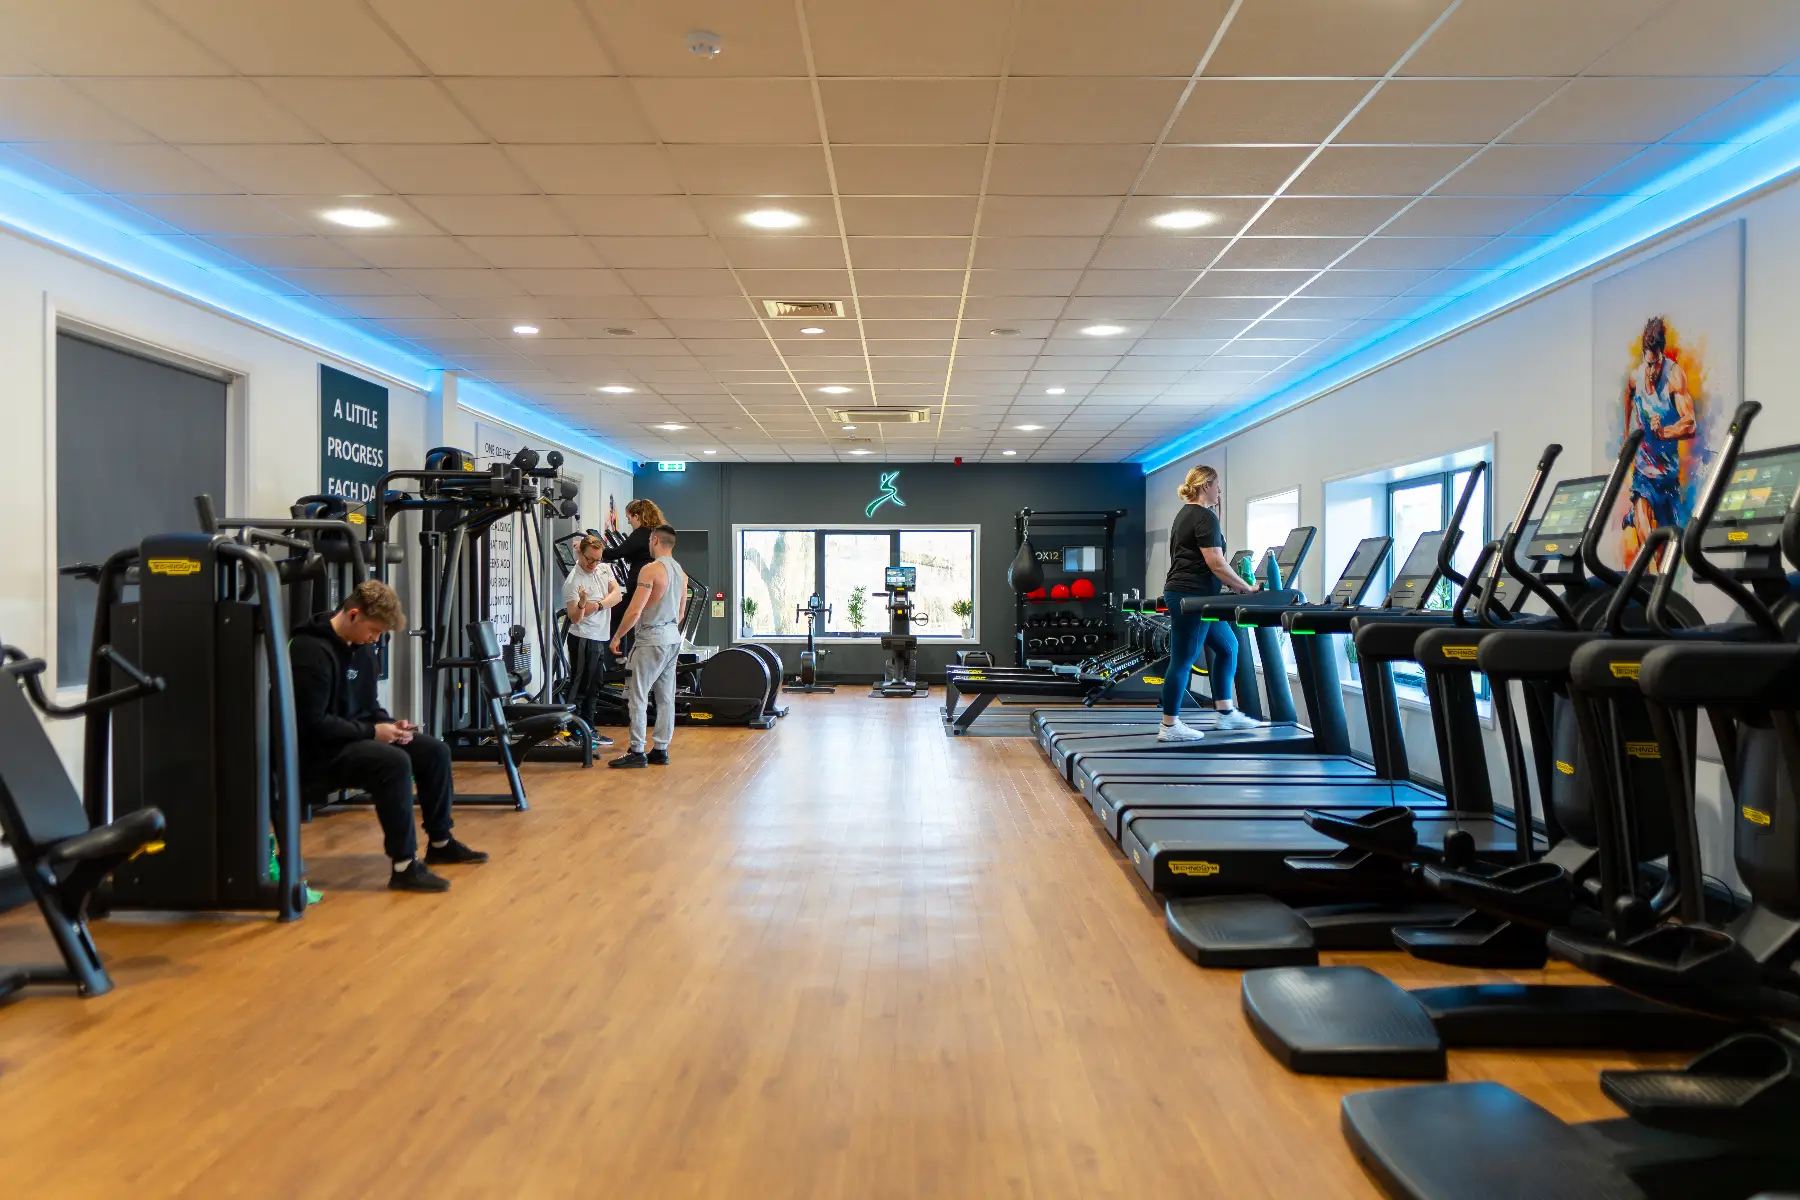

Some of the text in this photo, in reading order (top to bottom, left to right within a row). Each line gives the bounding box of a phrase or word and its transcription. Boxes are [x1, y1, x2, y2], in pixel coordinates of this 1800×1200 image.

[333, 398, 378, 429] A LITTLE
[327, 436, 384, 468] PROGRESS
[485, 442, 511, 460] ONE OF THE
[328, 477, 376, 502] EACH DA
[498, 539, 509, 551] TWO
[1035, 551, 1059, 560] OX12
[500, 559, 511, 569] AGO
[498, 577, 511, 588] BODY
[499, 613, 510, 624] YOU
